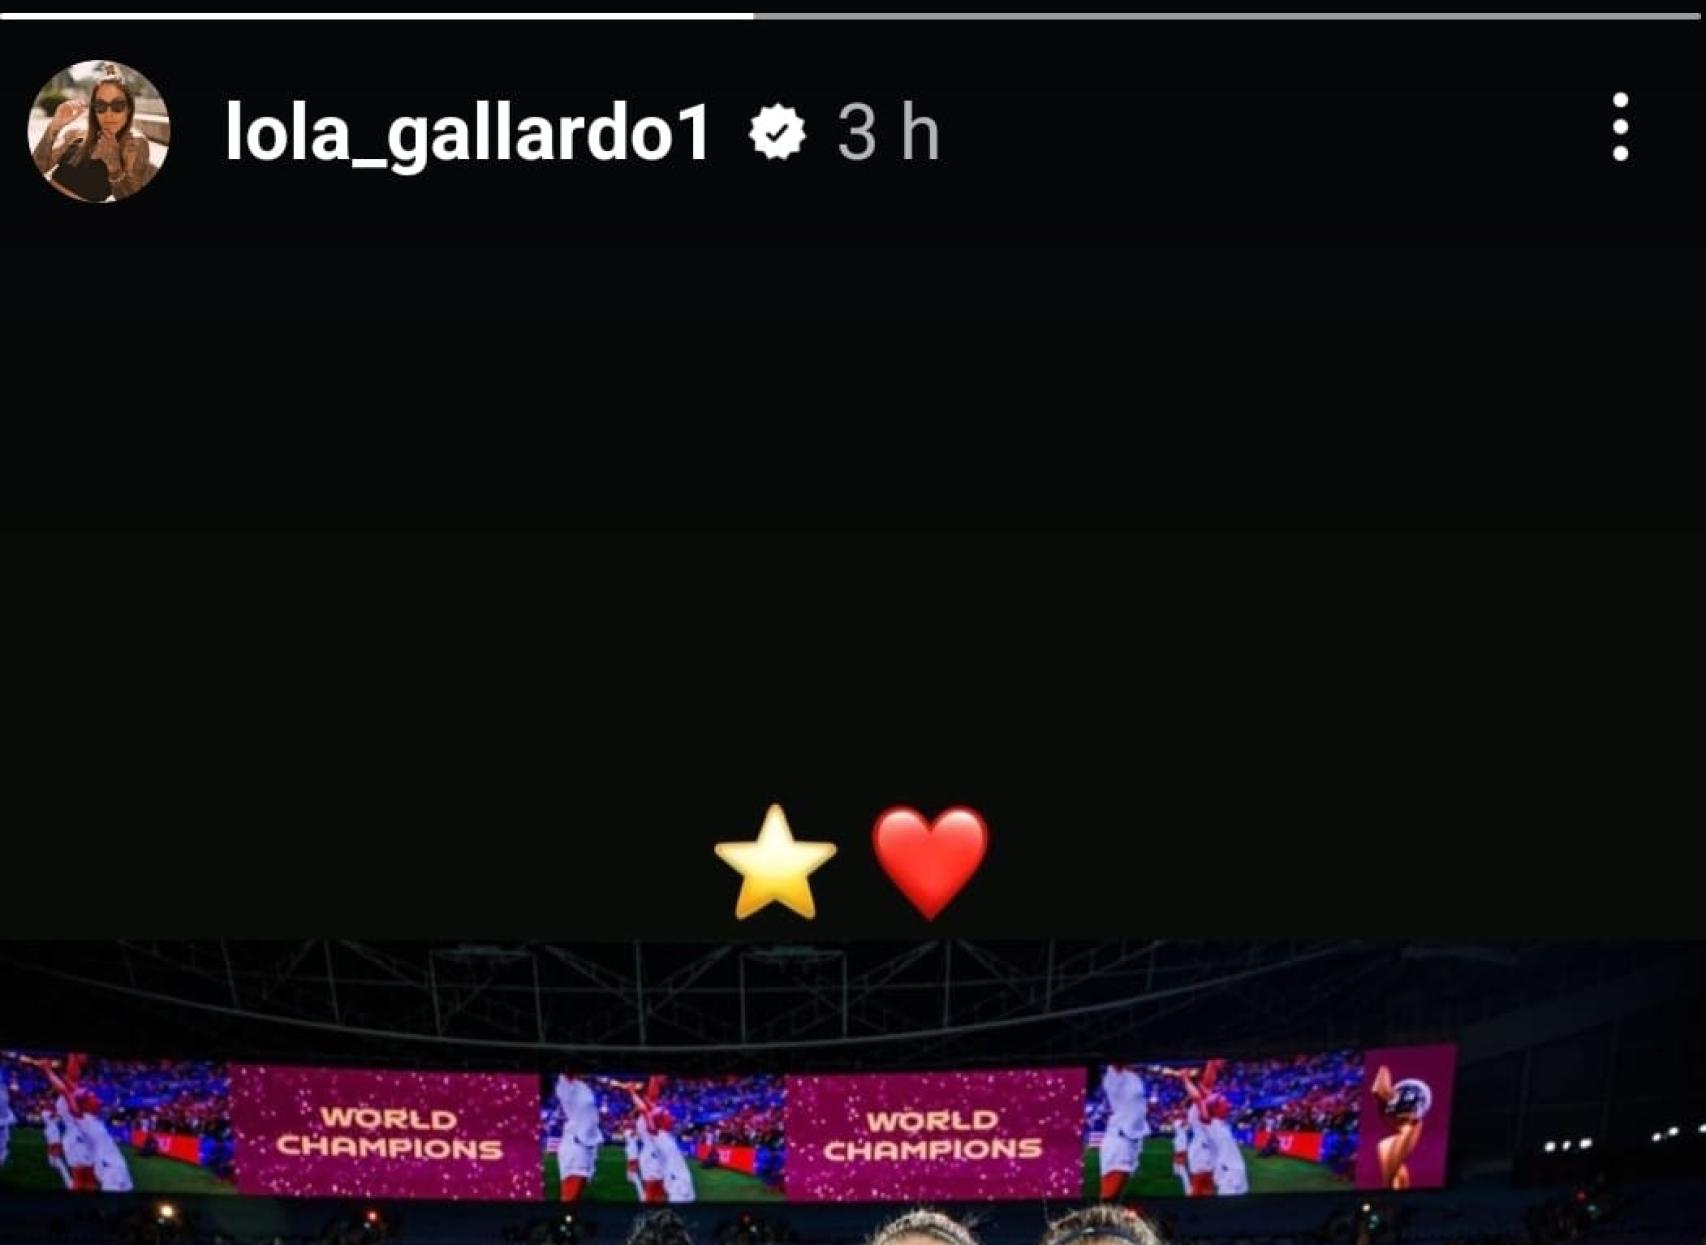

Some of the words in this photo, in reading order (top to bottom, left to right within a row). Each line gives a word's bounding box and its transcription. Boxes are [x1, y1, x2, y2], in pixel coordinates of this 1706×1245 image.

[320, 1107, 457, 1130] WORLD
[867, 1109, 999, 1132] WORLD
[276, 1134, 504, 1160] CHAMPIONS
[824, 1137, 1042, 1161] CHAMPIONS
